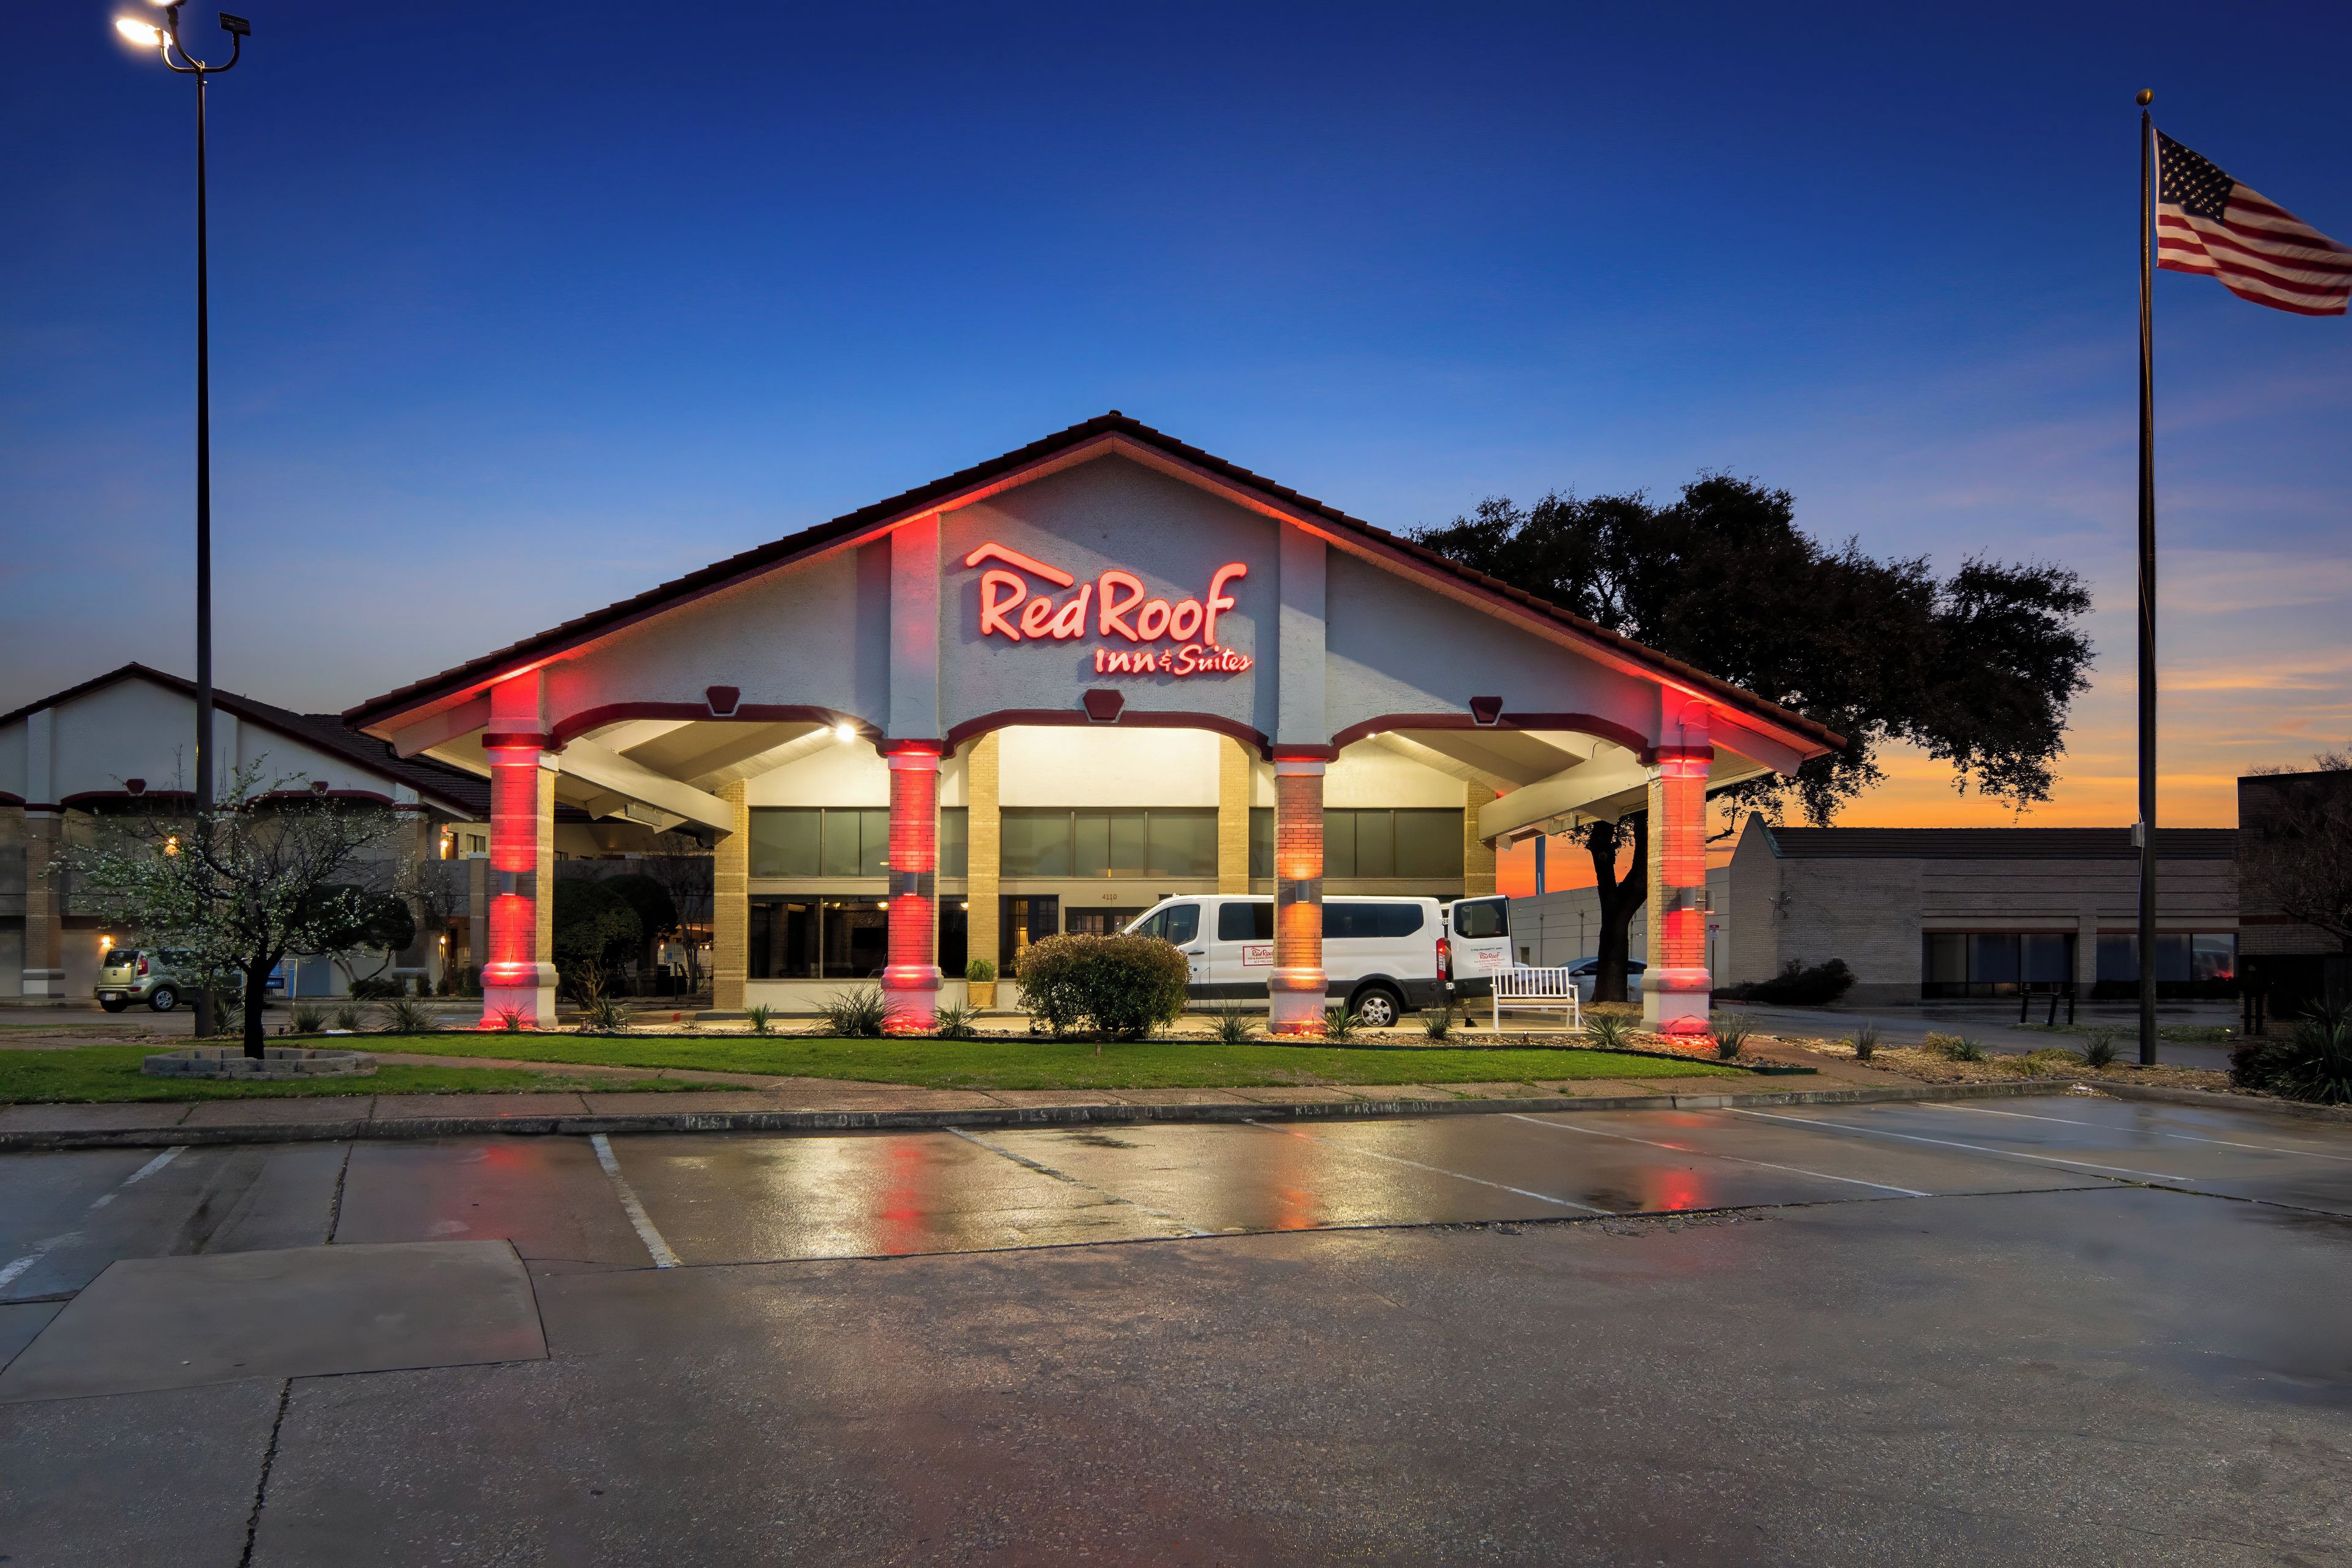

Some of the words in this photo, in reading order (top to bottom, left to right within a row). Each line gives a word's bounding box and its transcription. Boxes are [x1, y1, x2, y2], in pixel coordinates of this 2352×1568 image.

[979, 570, 1092, 642] Red
[1098, 562, 1248, 646] Roof
[1095, 648, 1156, 674] Inn
[1158, 649, 1172, 673] &
[1173, 644, 1254, 676] Suites
